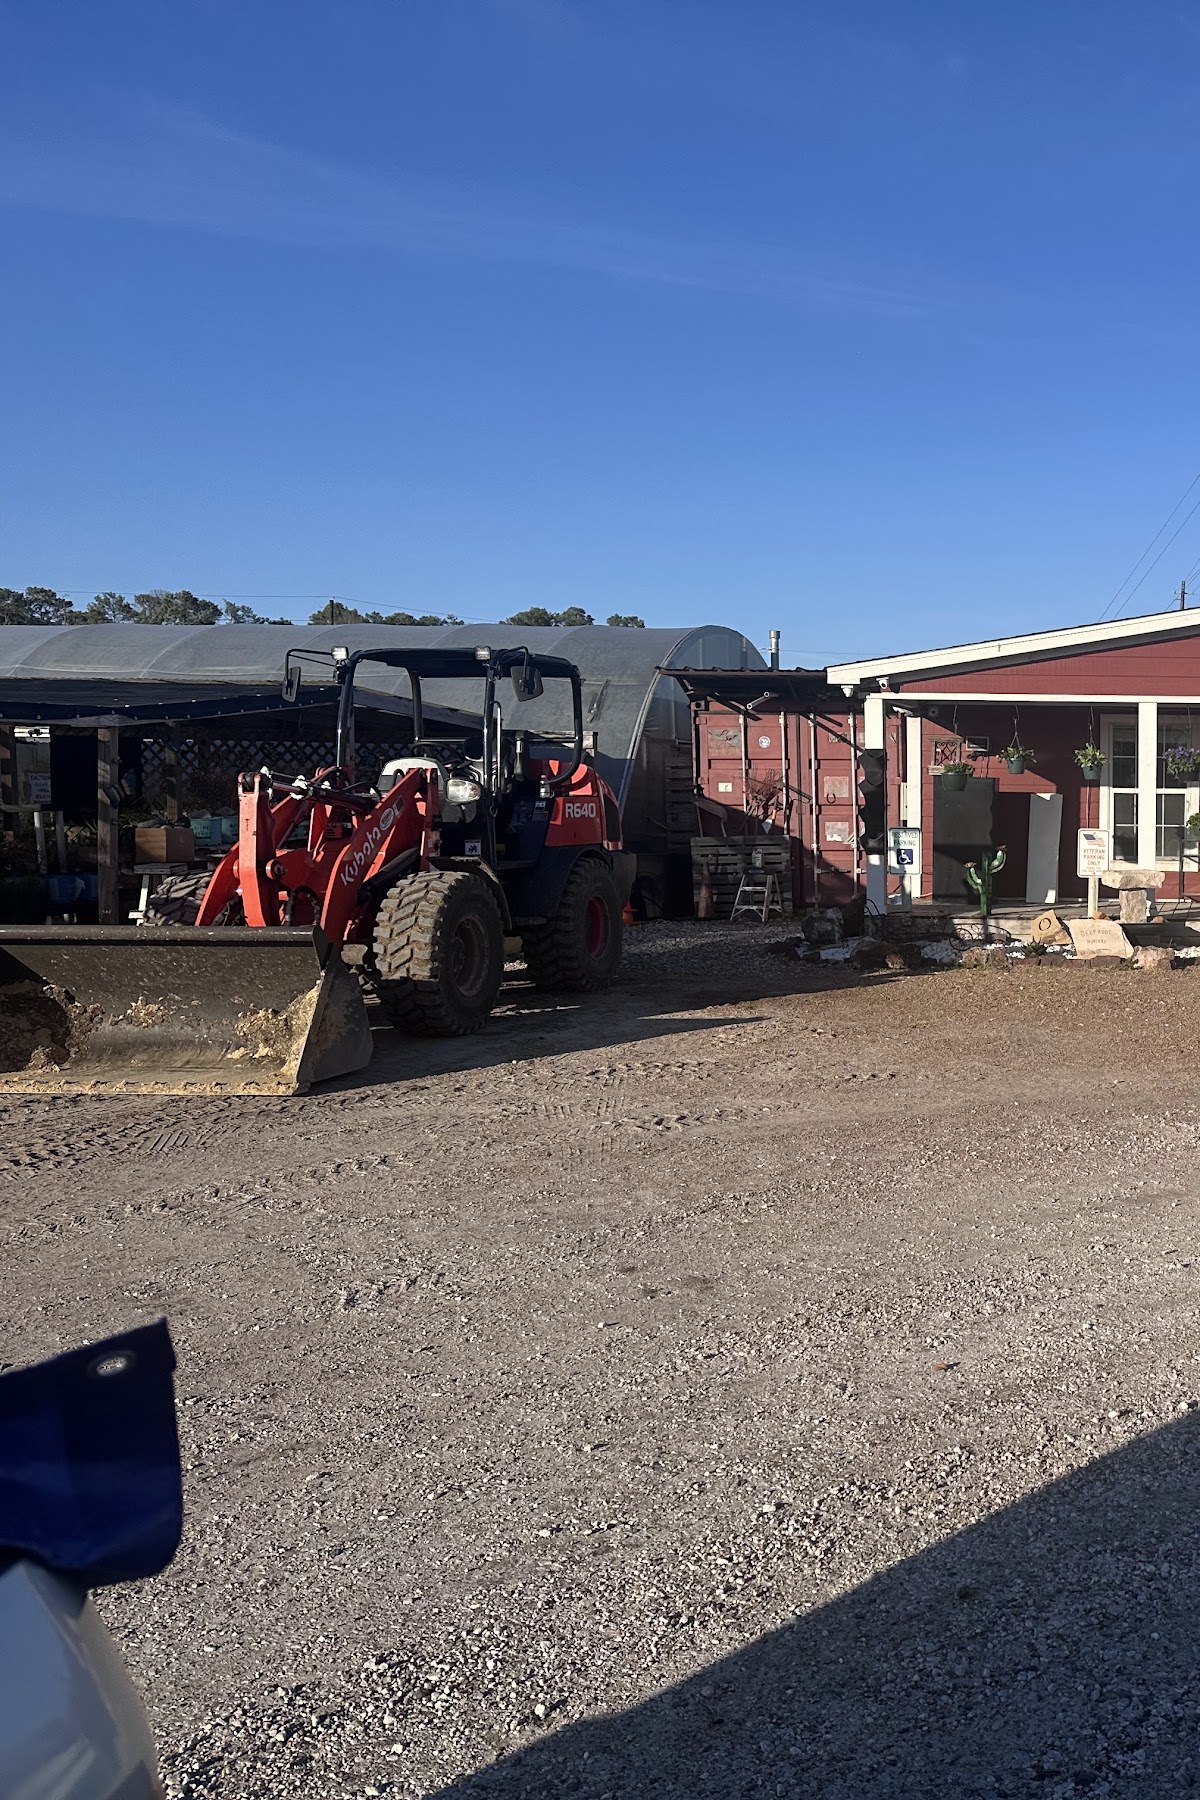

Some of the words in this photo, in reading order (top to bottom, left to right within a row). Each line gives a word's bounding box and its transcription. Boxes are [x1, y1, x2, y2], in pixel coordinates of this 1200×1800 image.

[565, 803, 596, 818] R640
[892, 831, 919, 839] RESERVED
[893, 839, 917, 847] PARKING
[340, 827, 382, 886] Kubota
